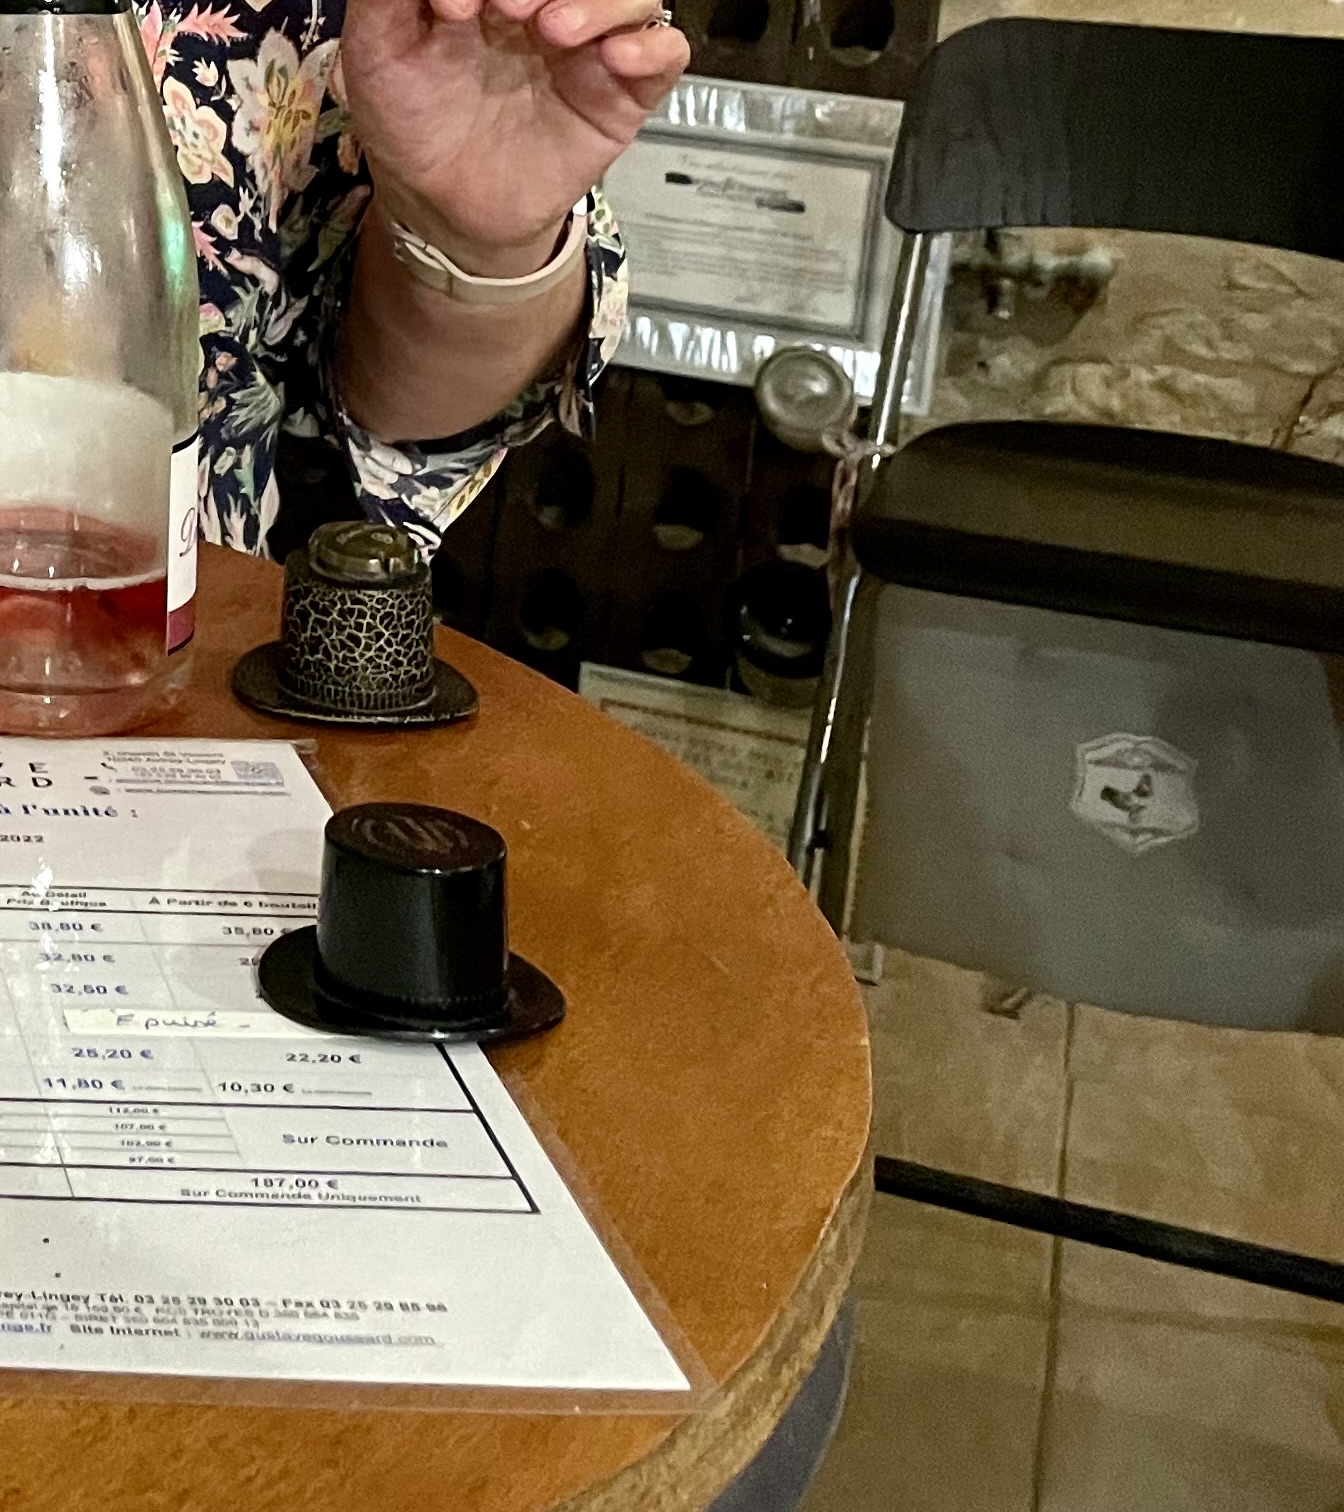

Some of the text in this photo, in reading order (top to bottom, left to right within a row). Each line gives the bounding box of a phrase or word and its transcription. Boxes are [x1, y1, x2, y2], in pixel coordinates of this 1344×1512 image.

[22, 803, 118, 818] l'unité
[285, 1052, 342, 1064] 22,20
[217, 1081, 275, 1095] 10,30
[282, 1132, 448, 1149] Sur Commande
